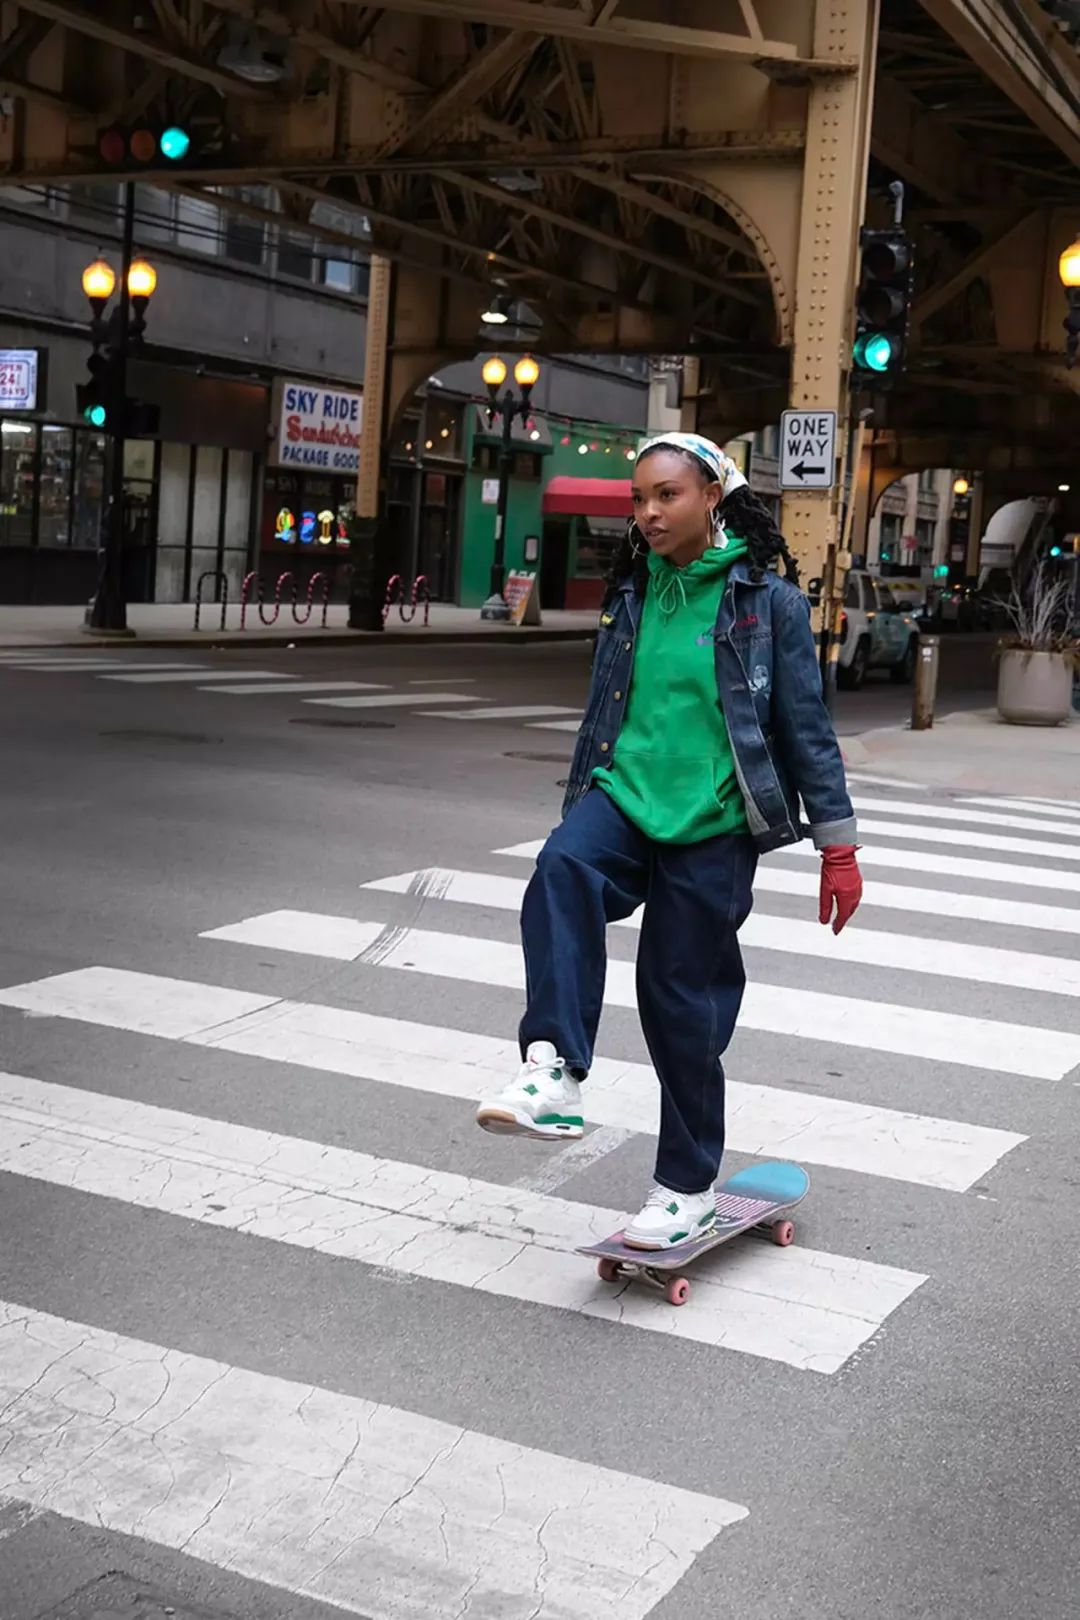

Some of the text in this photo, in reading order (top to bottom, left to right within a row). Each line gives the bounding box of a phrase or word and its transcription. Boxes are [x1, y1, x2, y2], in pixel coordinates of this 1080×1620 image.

[286, 388, 358, 420] SKY RIDE
[789, 418, 828, 435] ONE
[283, 445, 328, 466] PACKAGE
[787, 440, 828, 456] WAY
